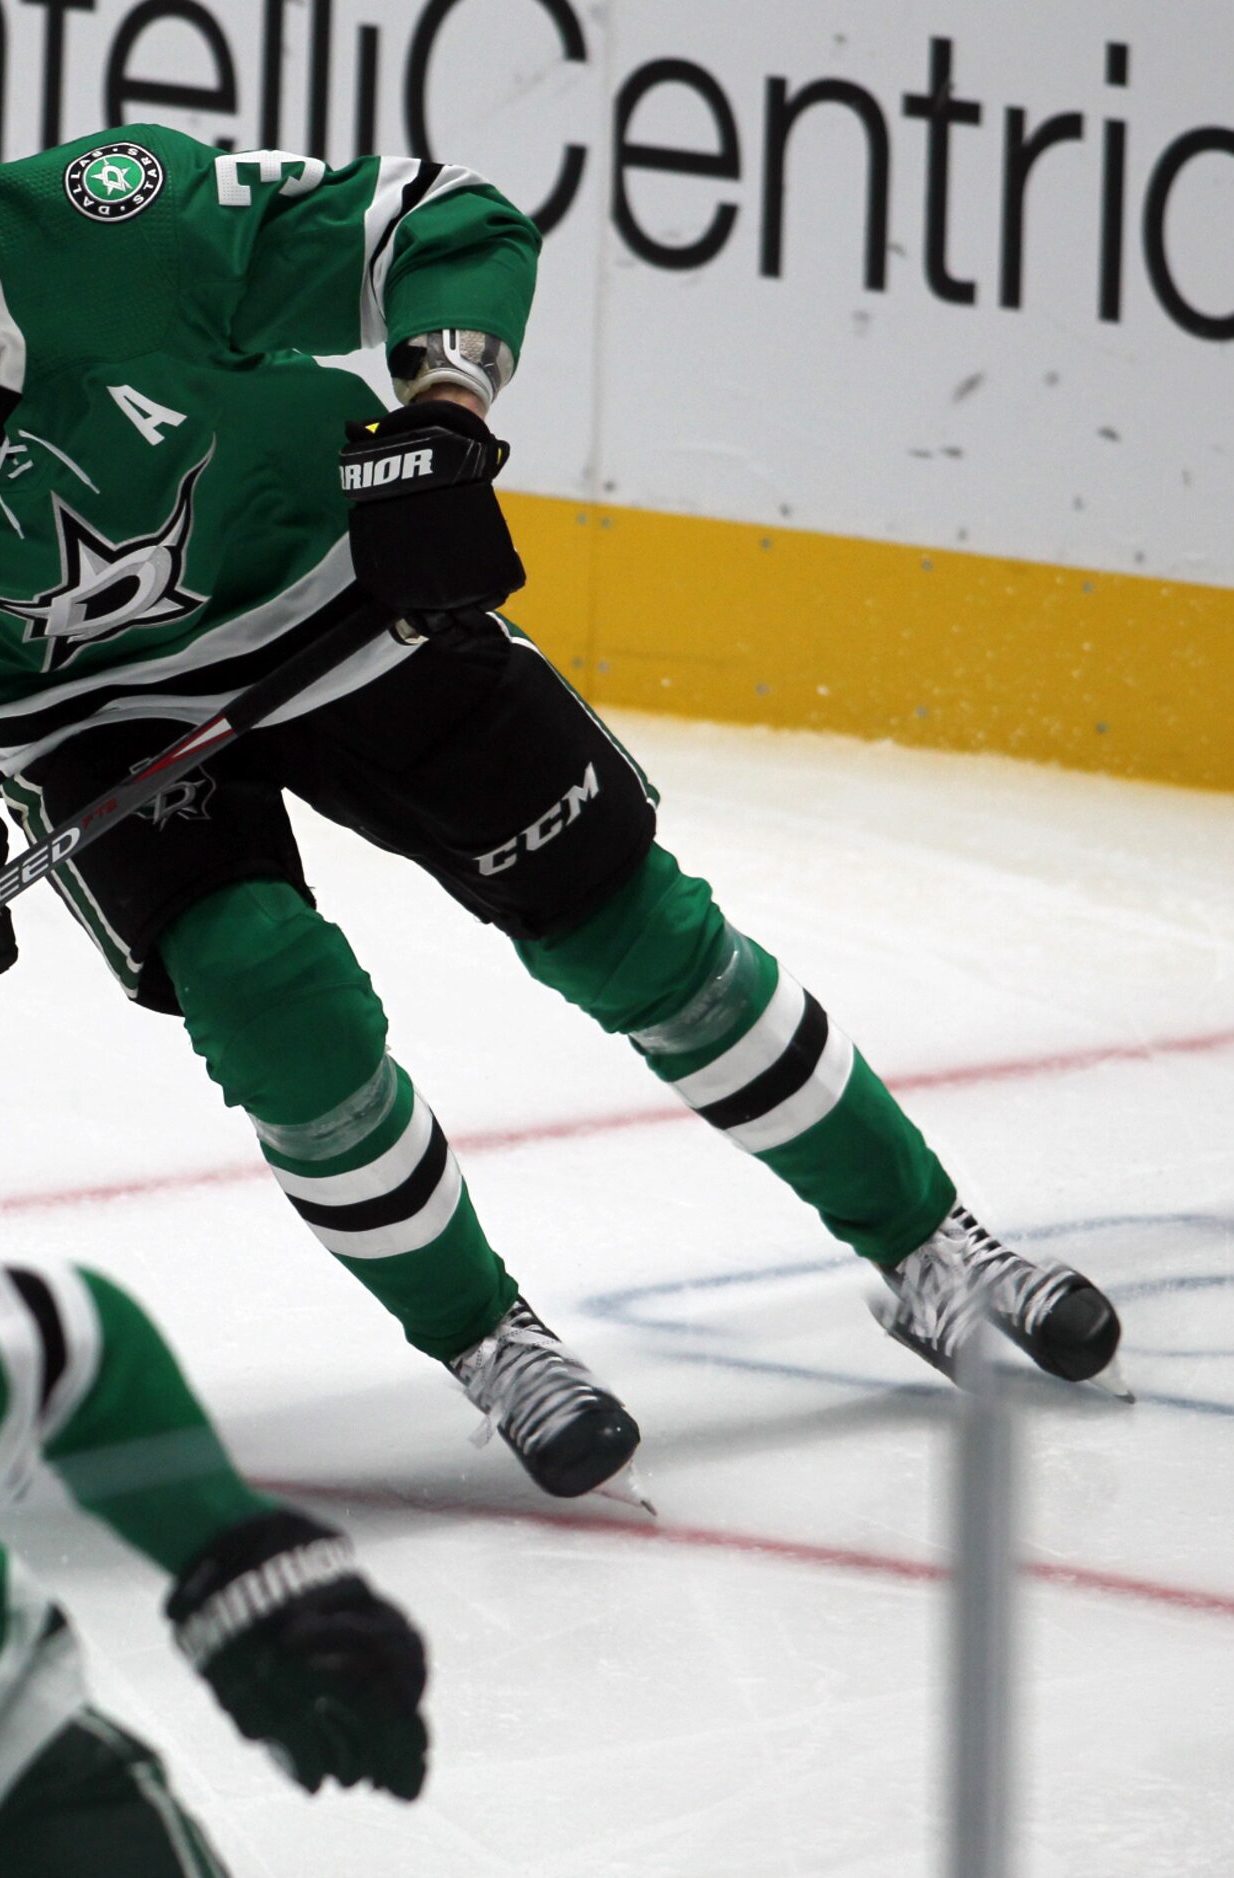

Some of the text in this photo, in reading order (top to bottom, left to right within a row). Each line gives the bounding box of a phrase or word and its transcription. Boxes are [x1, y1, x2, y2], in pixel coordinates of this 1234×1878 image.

[70, 149, 112, 216] DALLAS
[126, 147, 159, 205] STARS
[214, 149, 326, 206] 3
[106, 384, 188, 446] A
[339, 448, 434, 491] RIOR
[472, 761, 600, 876] CCM
